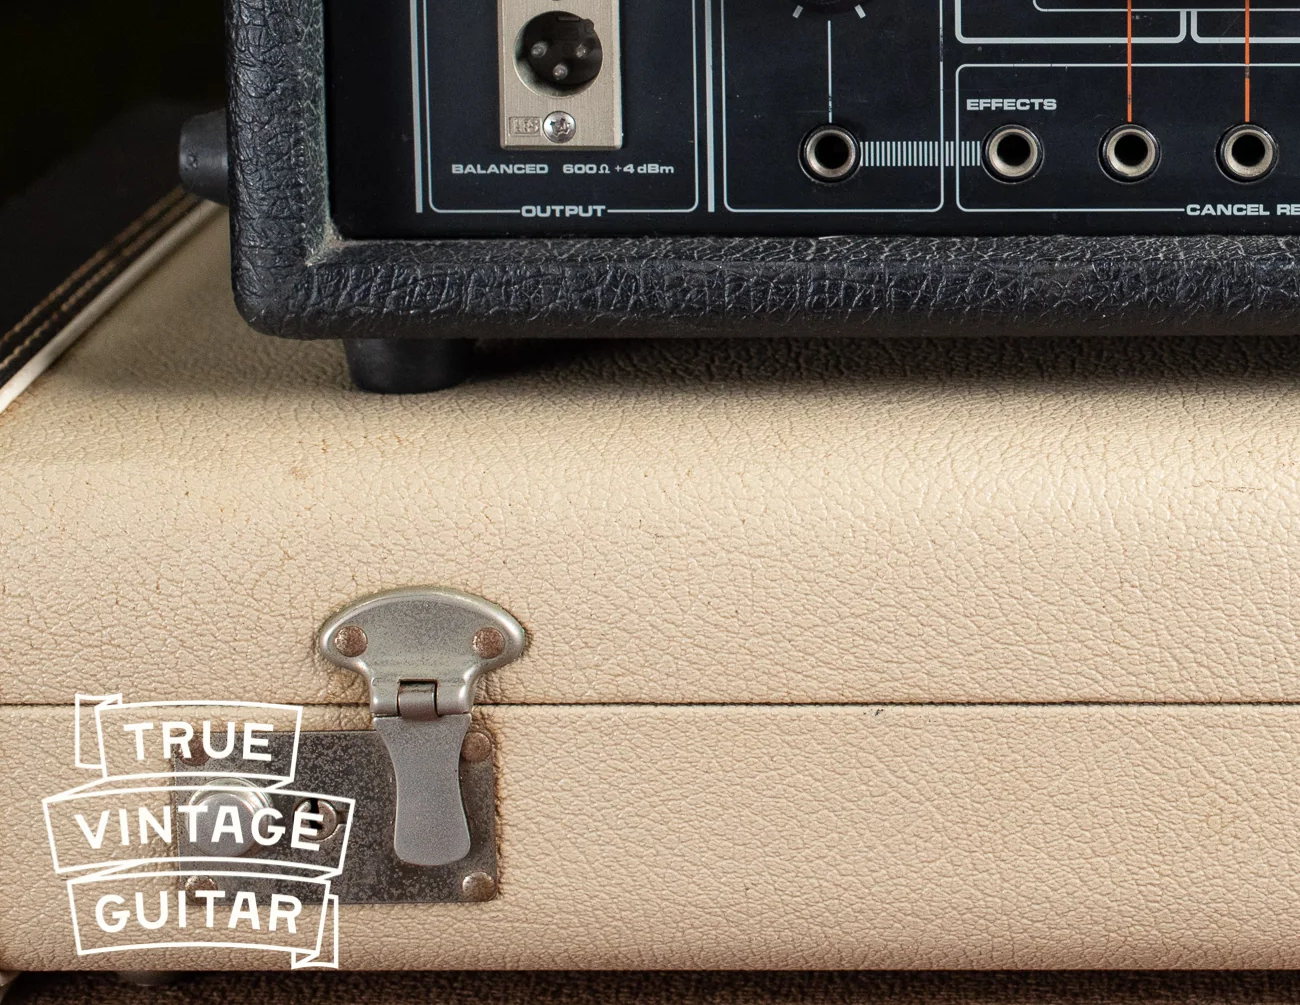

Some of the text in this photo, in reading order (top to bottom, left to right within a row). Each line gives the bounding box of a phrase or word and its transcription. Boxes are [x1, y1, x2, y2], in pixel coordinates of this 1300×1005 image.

[967, 99, 1056, 110] EFFECTS
[452, 164, 548, 173] BALANCED
[615, 164, 634, 173] +4
[637, 164, 674, 173] dBm
[522, 206, 606, 217] OUTPUT
[1187, 204, 1270, 215] CANCEL
